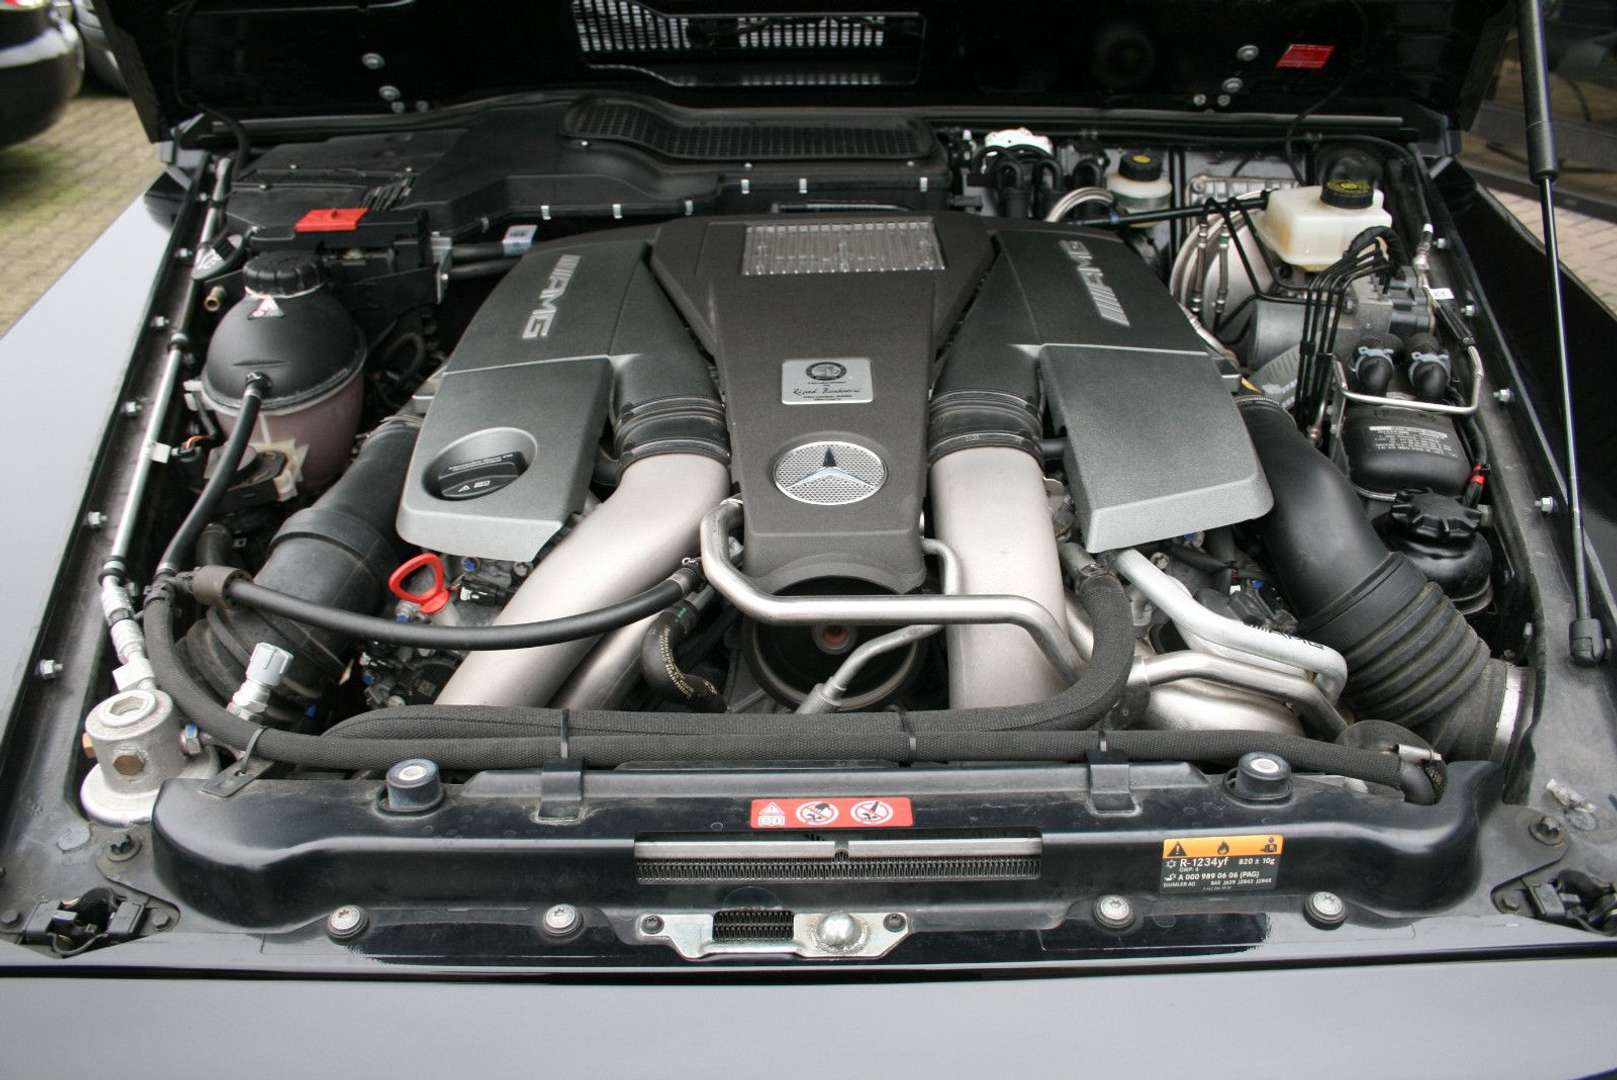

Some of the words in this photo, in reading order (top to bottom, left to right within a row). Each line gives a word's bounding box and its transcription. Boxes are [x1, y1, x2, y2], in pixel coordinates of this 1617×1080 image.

[523, 270, 575, 338] AMG
[1180, 857, 1230, 868] R-1234yf
[1240, 871, 1260, 879] (PAG)
